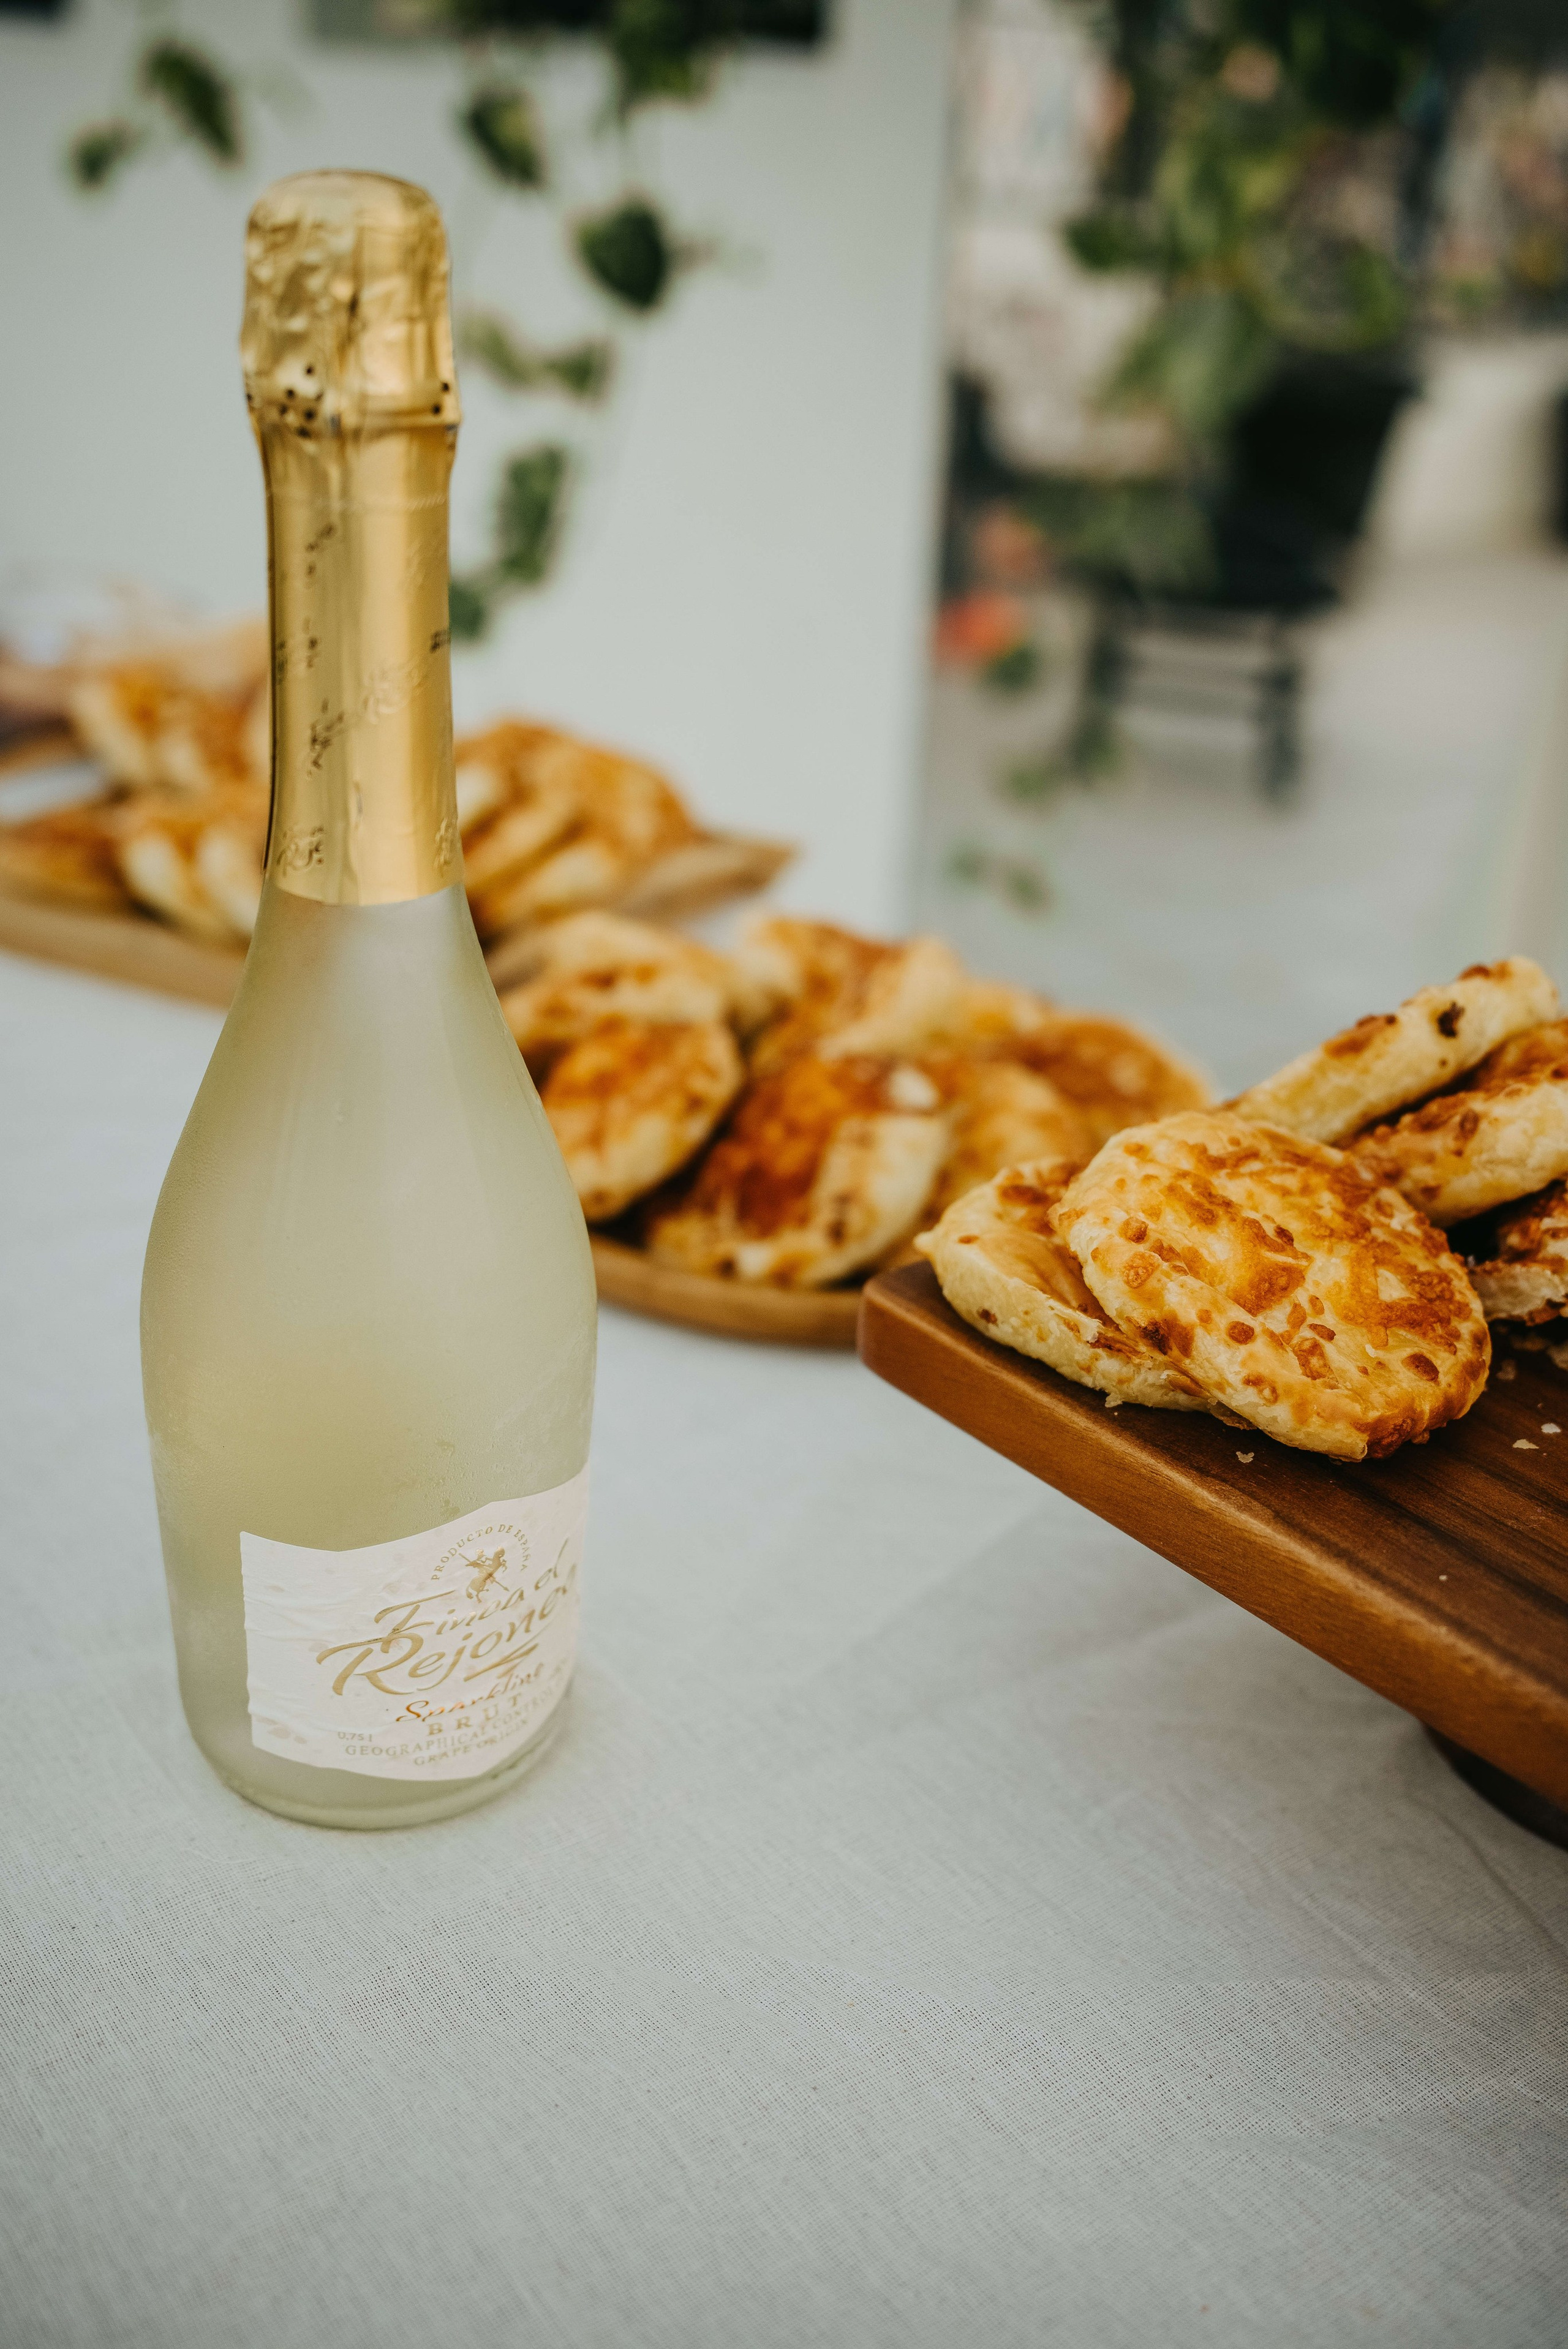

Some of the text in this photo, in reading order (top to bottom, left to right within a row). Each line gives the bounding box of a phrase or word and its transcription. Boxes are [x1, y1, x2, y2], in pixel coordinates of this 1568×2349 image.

[431, 1526, 493, 1581] PRODUCTO
[497, 1523, 513, 1534] DE
[374, 1586, 525, 1654] Finca
[427, 1692, 521, 1736] BRUT
[413, 1745, 472, 1767] GRAPE
